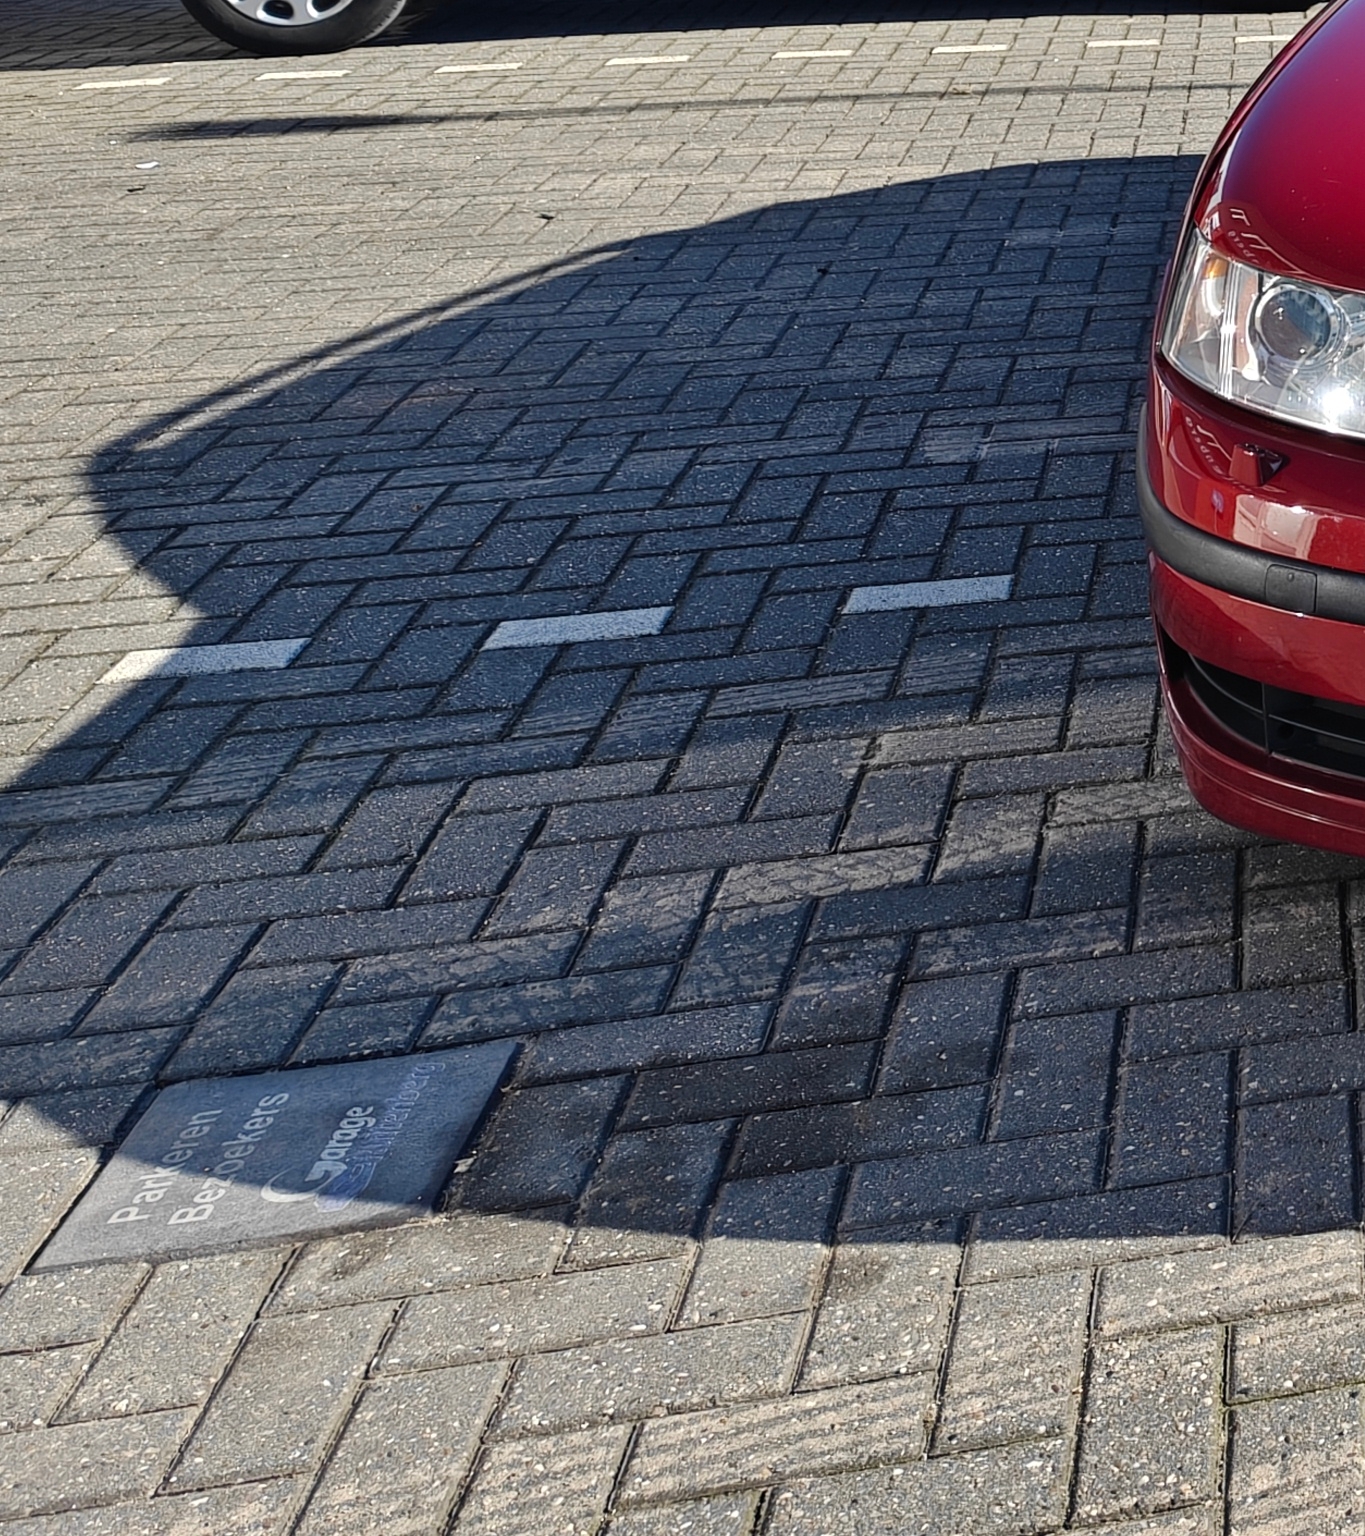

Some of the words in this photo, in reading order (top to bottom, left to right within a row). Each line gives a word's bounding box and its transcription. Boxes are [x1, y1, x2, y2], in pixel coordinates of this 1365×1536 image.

[106, 1109, 223, 1225] Parkeren
[167, 1092, 290, 1226] Bezoekers
[260, 1105, 377, 1203] Garage
